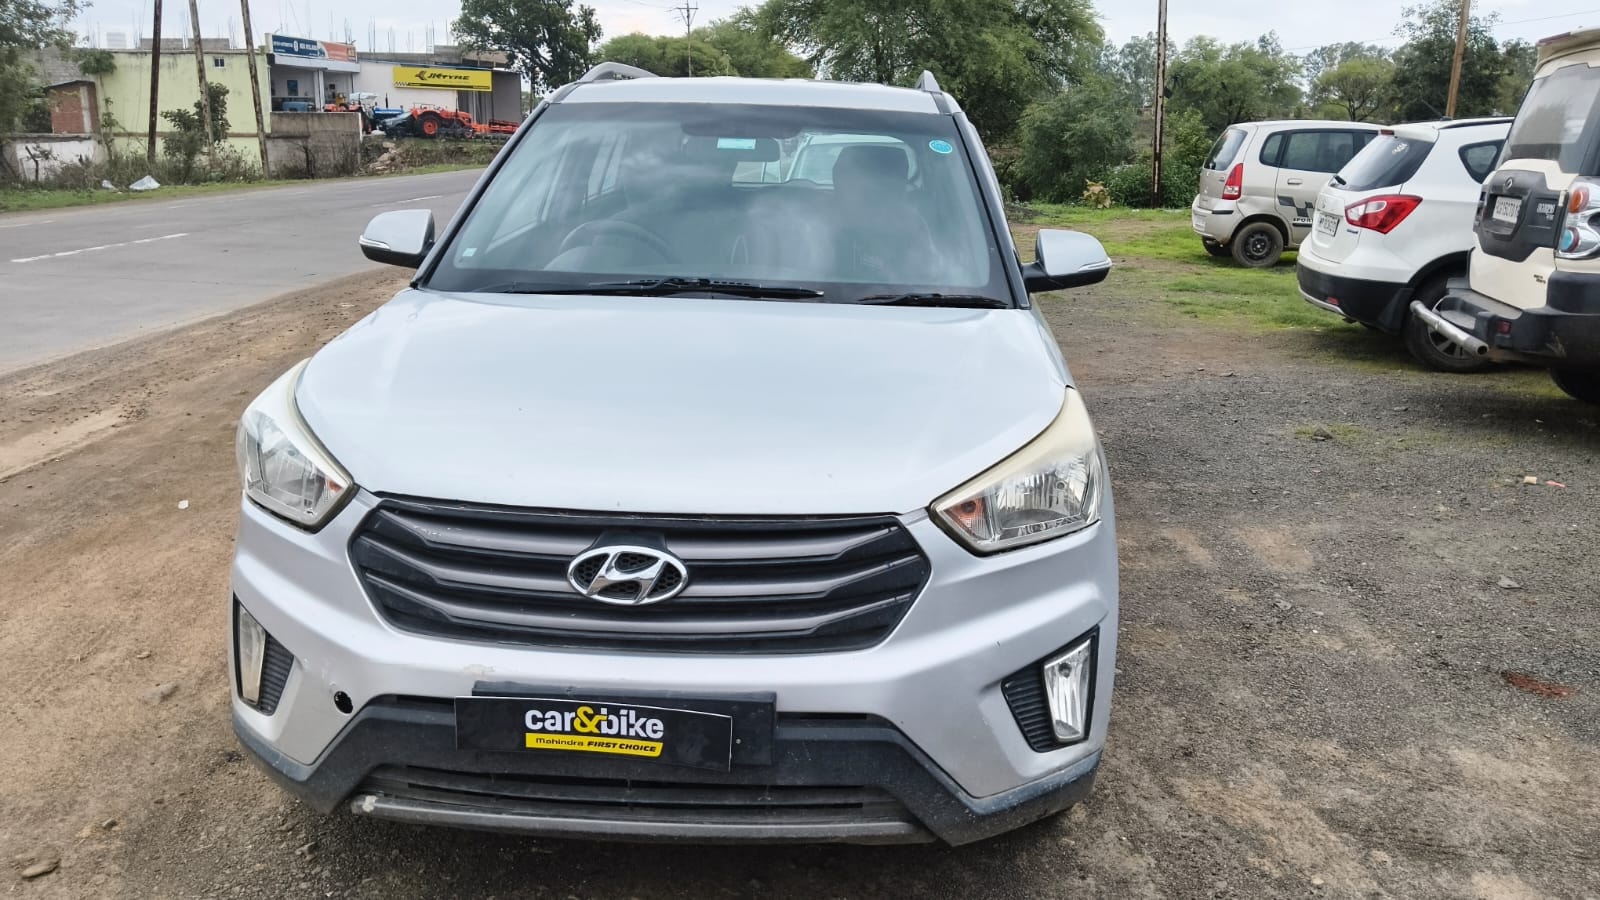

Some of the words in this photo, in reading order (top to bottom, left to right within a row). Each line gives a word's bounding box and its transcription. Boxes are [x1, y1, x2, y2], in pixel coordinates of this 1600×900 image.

[525, 706, 664, 739] car&bike
[535, 737, 584, 747] Mahindra
[587, 741, 617, 749] FIRST
[619, 742, 657, 752] CHOICE
